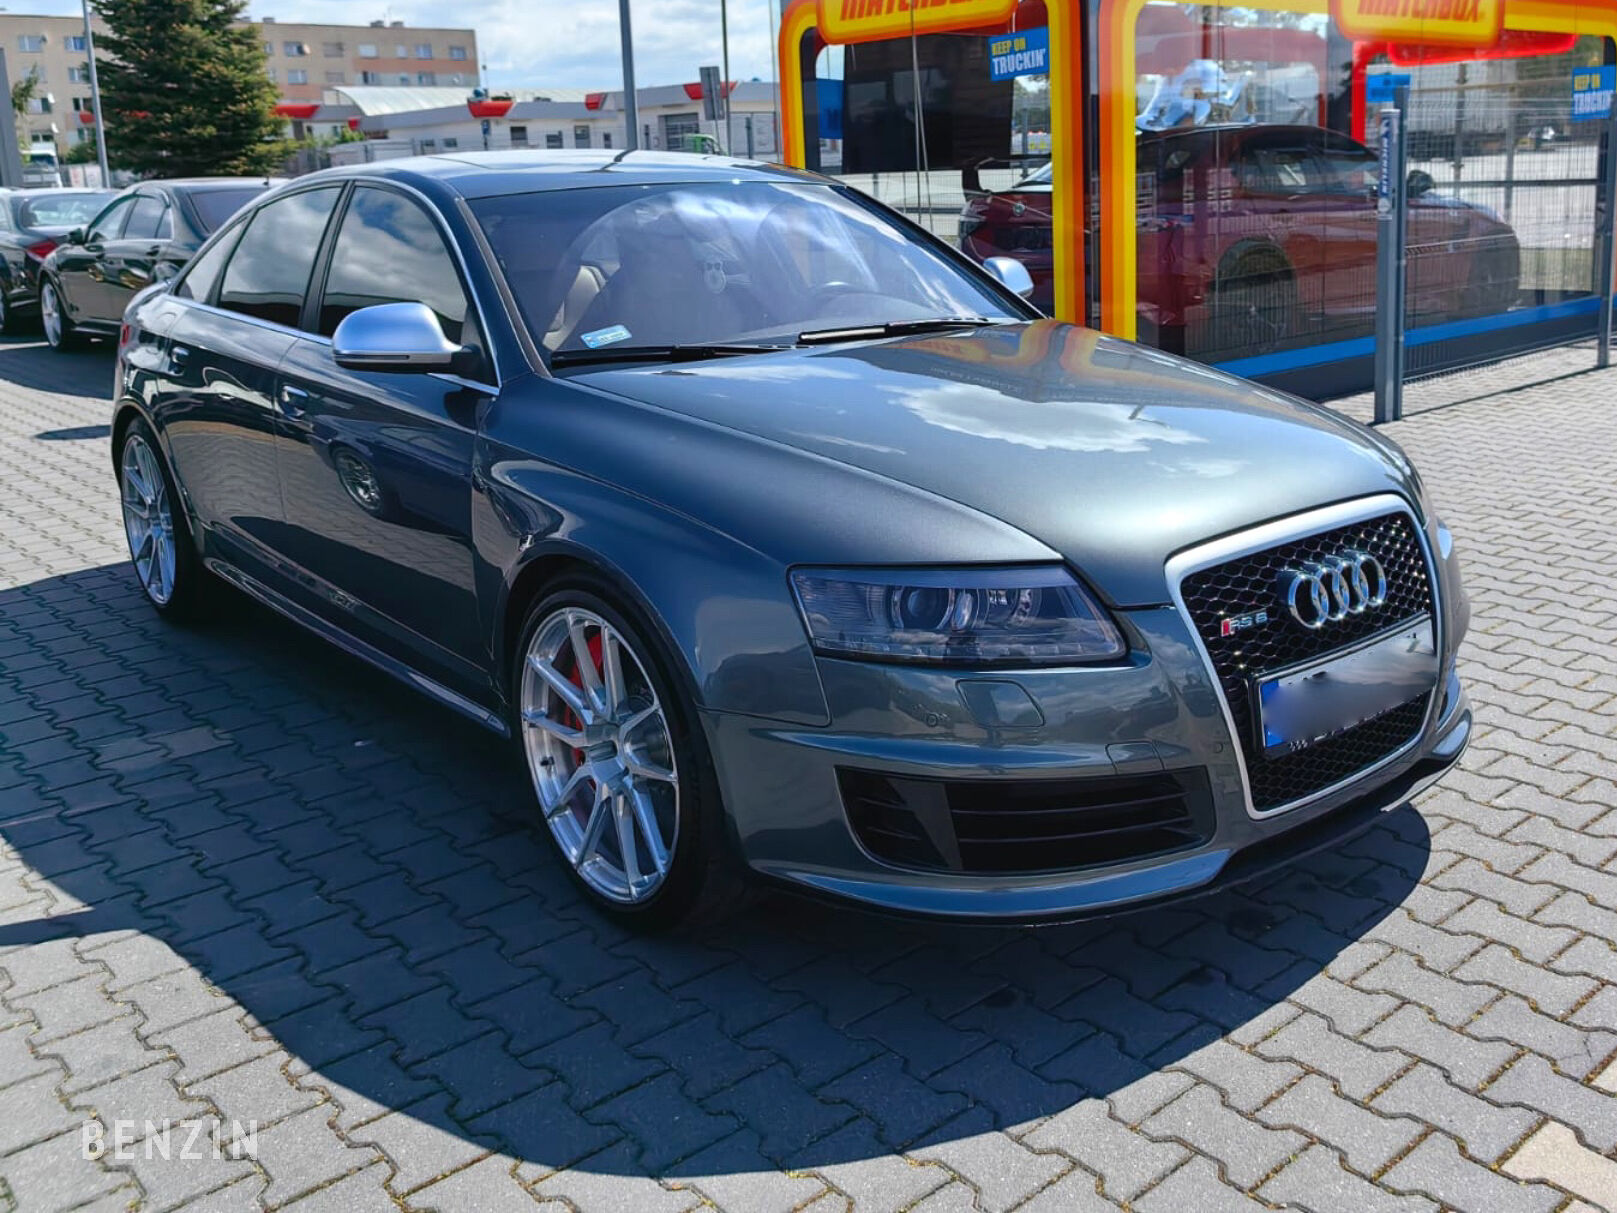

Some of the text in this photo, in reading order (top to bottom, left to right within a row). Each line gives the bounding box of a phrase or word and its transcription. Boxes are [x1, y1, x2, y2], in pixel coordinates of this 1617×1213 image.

[991, 37, 1026, 56] KEEP ON
[992, 48, 1046, 75] TRUCKIN'
